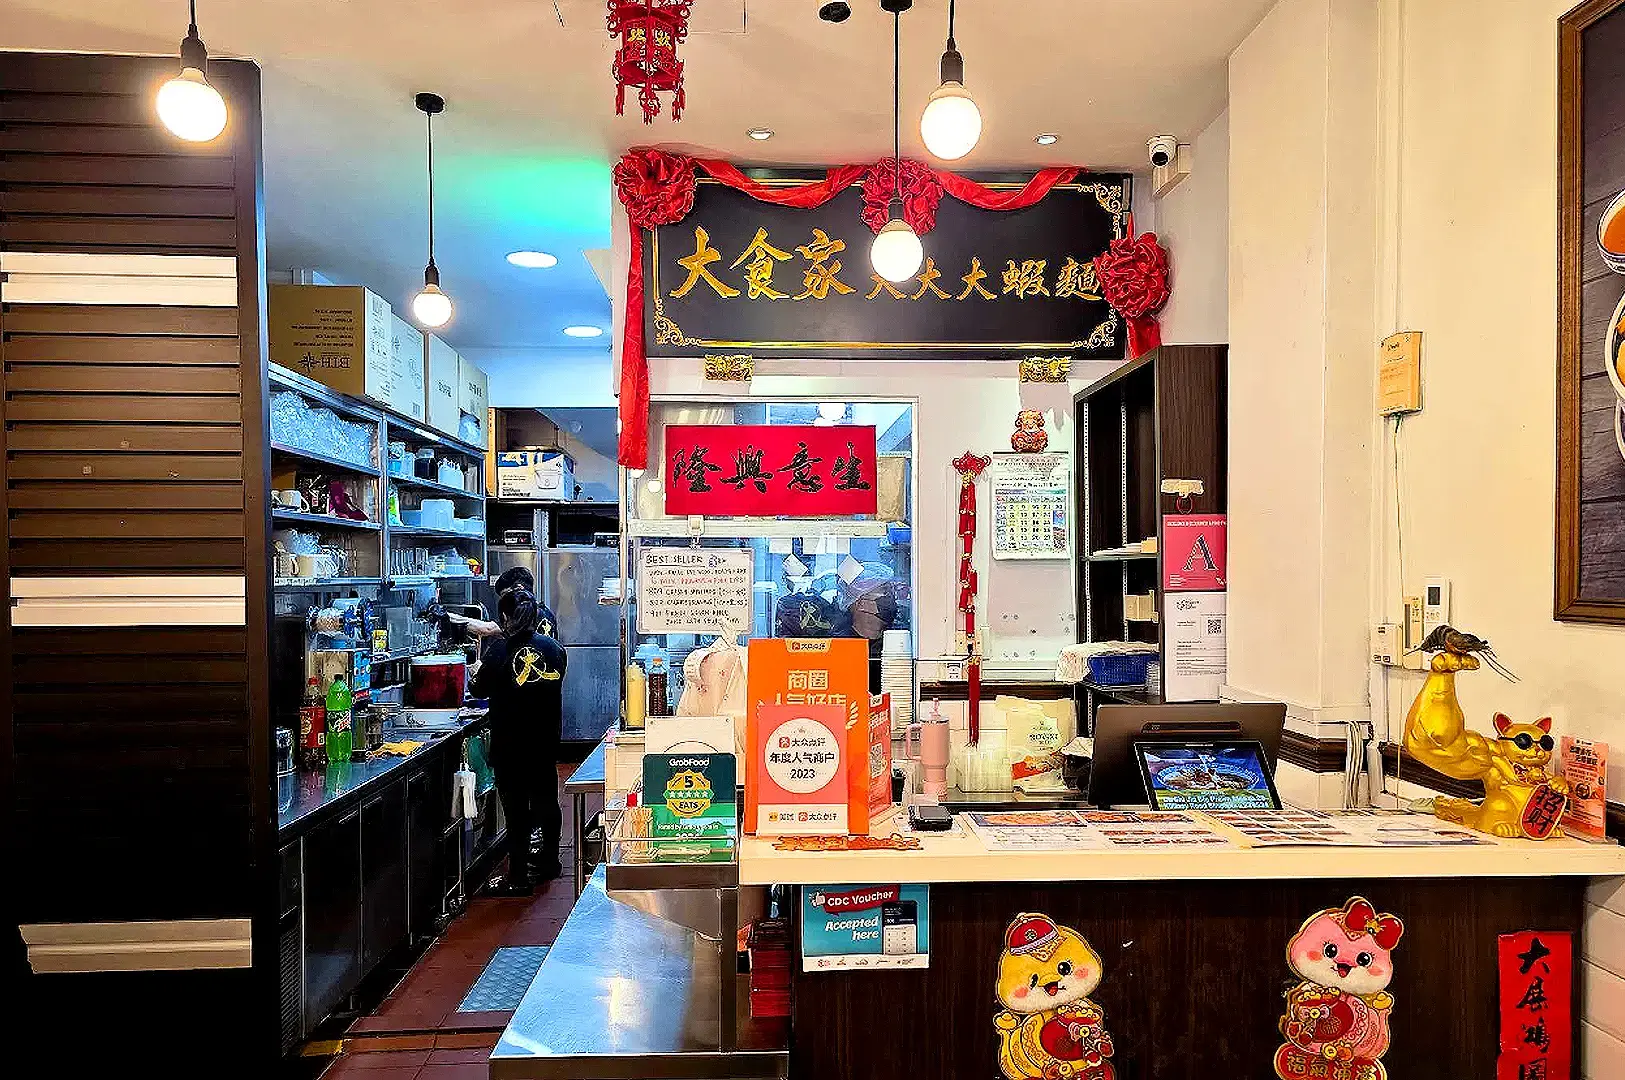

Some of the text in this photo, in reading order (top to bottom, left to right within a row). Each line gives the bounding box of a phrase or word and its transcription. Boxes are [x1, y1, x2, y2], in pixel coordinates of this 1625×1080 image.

[669, 226, 857, 300] 大食家
[1182, 533, 1218, 571] A
[516, 647, 560, 686] 大
[787, 669, 829, 690] 商圈
[791, 737, 826, 747] 大众点评
[669, 758, 710, 767] GrabFood
[769, 751, 836, 764] 年度人气商户
[790, 768, 816, 779] 2023
[684, 775, 695, 788] 5
[679, 801, 699, 809] EATS
[827, 891, 895, 907] CDC Voucher
[825, 915, 880, 932] Accepted
[852, 930, 880, 942] here
